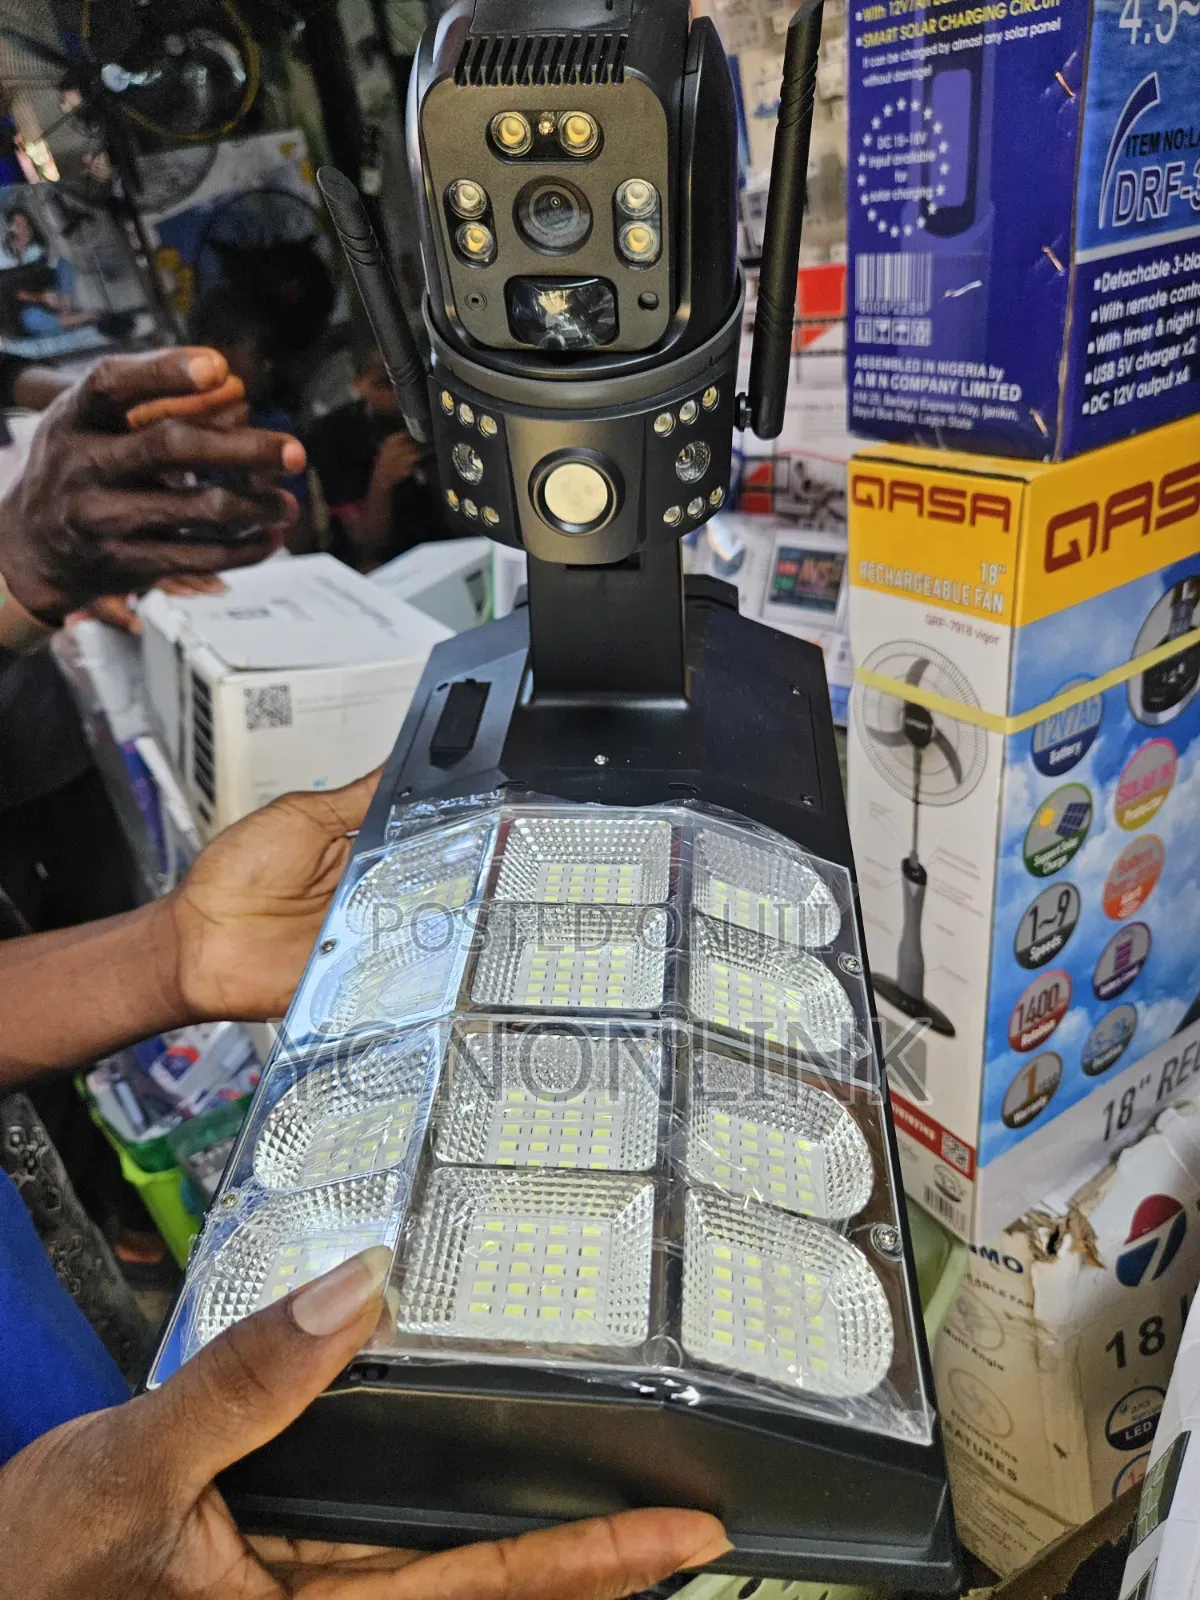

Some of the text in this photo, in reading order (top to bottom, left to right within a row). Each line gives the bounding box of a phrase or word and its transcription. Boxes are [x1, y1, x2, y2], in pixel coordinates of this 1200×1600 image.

[863, 27, 899, 48] SMART
[900, 19, 936, 40] SOLAR
[938, 2, 1008, 32] CHARGING
[900, 43, 937, 62] charged
[938, 42, 950, 55] by
[952, 34, 983, 51] almost
[984, 31, 1003, 46] any
[1004, 24, 1029, 41] solar
[1030, 17, 1061, 38] panel
[1126, 131, 1160, 158] ITEM
[869, 186, 933, 202] solar charging
[1101, 258, 1170, 293] Detachable
[1100, 300, 1124, 323] With
[1126, 289, 1168, 316] remote
[1096, 330, 1122, 355] With
[1124, 323, 1154, 346] timer
[1155, 316, 1164, 338] &
[1166, 307, 1194, 336] night
[854, 354, 1005, 383] ASSEMBLED IN NIGERIA by
[1093, 335, 1198, 386] USB 5V charger x2
[890, 373, 960, 396] COMPANY
[961, 379, 1022, 402] LIMITED
[1090, 365, 1190, 416] DC 12V output x4
[851, 474, 1012, 534] QASA
[859, 560, 1004, 615] RECHARGEABLE FAN
[979, 561, 1006, 587] 18"
[1049, 741, 1083, 766] Battery
[1028, 889, 1071, 942] 1~9
[1029, 934, 1064, 963] Speeds
[1017, 983, 1060, 1033] 1400
[1022, 1064, 1037, 1098] 1
[1105, 1315, 1166, 1369] 18
[971, 1347, 1005, 1372] Angle
[1125, 1420, 1154, 1442] LED
